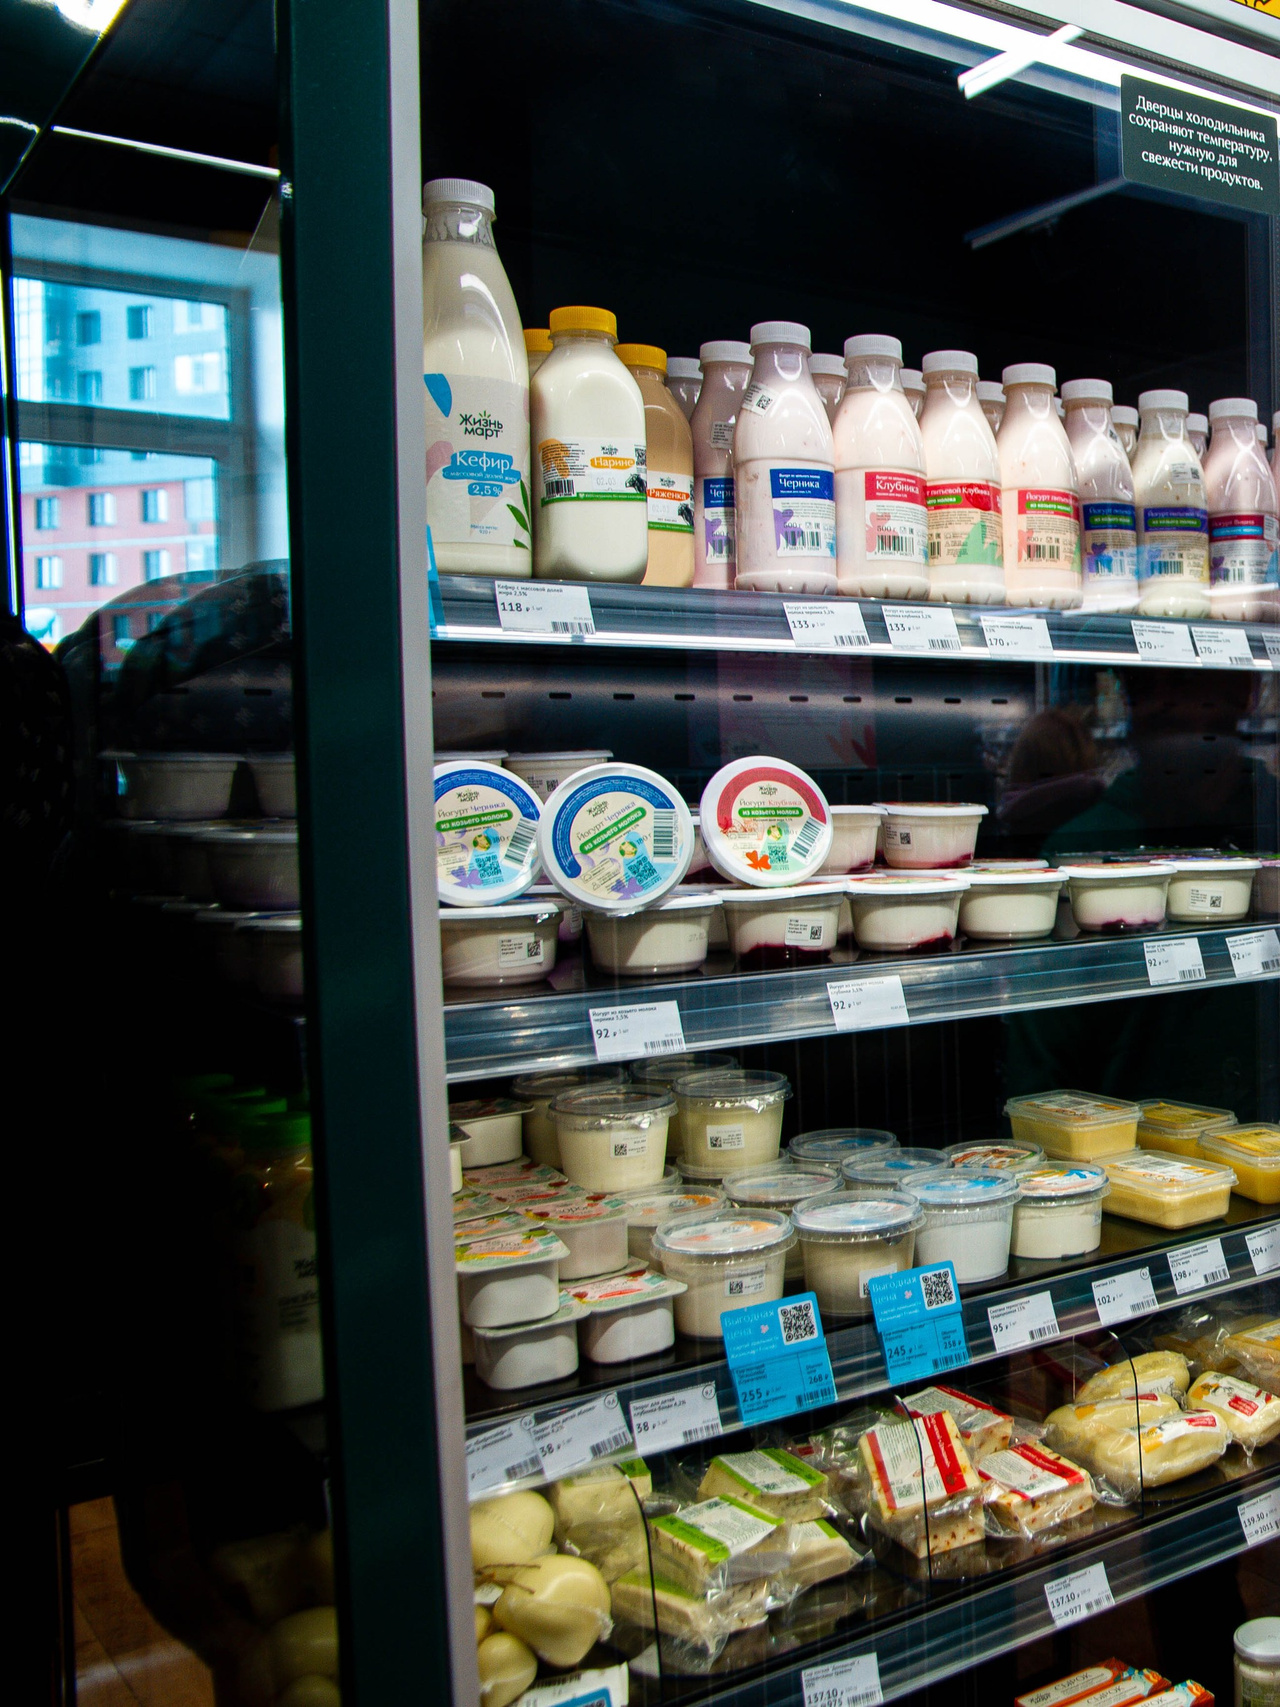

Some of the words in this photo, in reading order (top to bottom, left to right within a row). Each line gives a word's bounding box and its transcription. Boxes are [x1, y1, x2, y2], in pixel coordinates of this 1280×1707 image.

[1136, 95, 1183, 121] Дверцы
[1186, 111, 1265, 143] холодильника
[1129, 113, 1194, 139] сохраняют
[1169, 141, 1215, 162] нужную
[1217, 154, 1238, 168] для
[1141, 151, 1198, 174] свежести
[1201, 165, 1264, 190] продуктов.
[460, 413, 503, 429] Жизнь
[464, 427, 500, 440] март
[457, 452, 510, 474] Кефир
[594, 458, 634, 469] Нарине
[779, 478, 820, 490] Черника
[876, 481, 919, 495] Клубника
[649, 489, 687, 500] Ряженка
[501, 602, 522, 612] 118
[792, 620, 809, 629] 133
[889, 623, 906, 631] 133
[988, 637, 1005, 646] 170
[1138, 641, 1153, 650] 170
[438, 808, 469, 818] Йогурт
[470, 801, 506, 812] Черника
[739, 799, 765, 808] Йогурт
[767, 800, 802, 808] Клубника
[451, 817, 480, 827] козьего
[481, 812, 509, 822] молока
[576, 822, 605, 841] Йогурт
[604, 801, 636, 822] Черника
[584, 843, 593, 851] из
[592, 827, 618, 845] козьего
[617, 811, 643, 829] молока
[1147, 958, 1157, 967] 92
[1231, 952, 1241, 961] 92
[833, 1000, 846, 1011] 92
[595, 1028, 610, 1039] 92
[1251, 1247, 1264, 1258] 304
[1174, 1270, 1187, 1281] 198
[872, 1276, 917, 1292] Выгодная
[1097, 1294, 1111, 1306] 102
[724, 1308, 775, 1327] Выгодная
[993, 1322, 1004, 1334] 95
[943, 1340, 957, 1350] 258
[887, 1345, 906, 1359] 245
[808, 1375, 823, 1385] 268
[742, 1388, 763, 1403] 255
[636, 1421, 650, 1433] 38
[539, 1443, 555, 1457] 38
[1243, 1511, 1265, 1528] 139.30
[1050, 1591, 1076, 1609] 137.10
[1053, 1671, 1091, 1691] СЫРОК
[807, 1687, 838, 1704] 137.10
